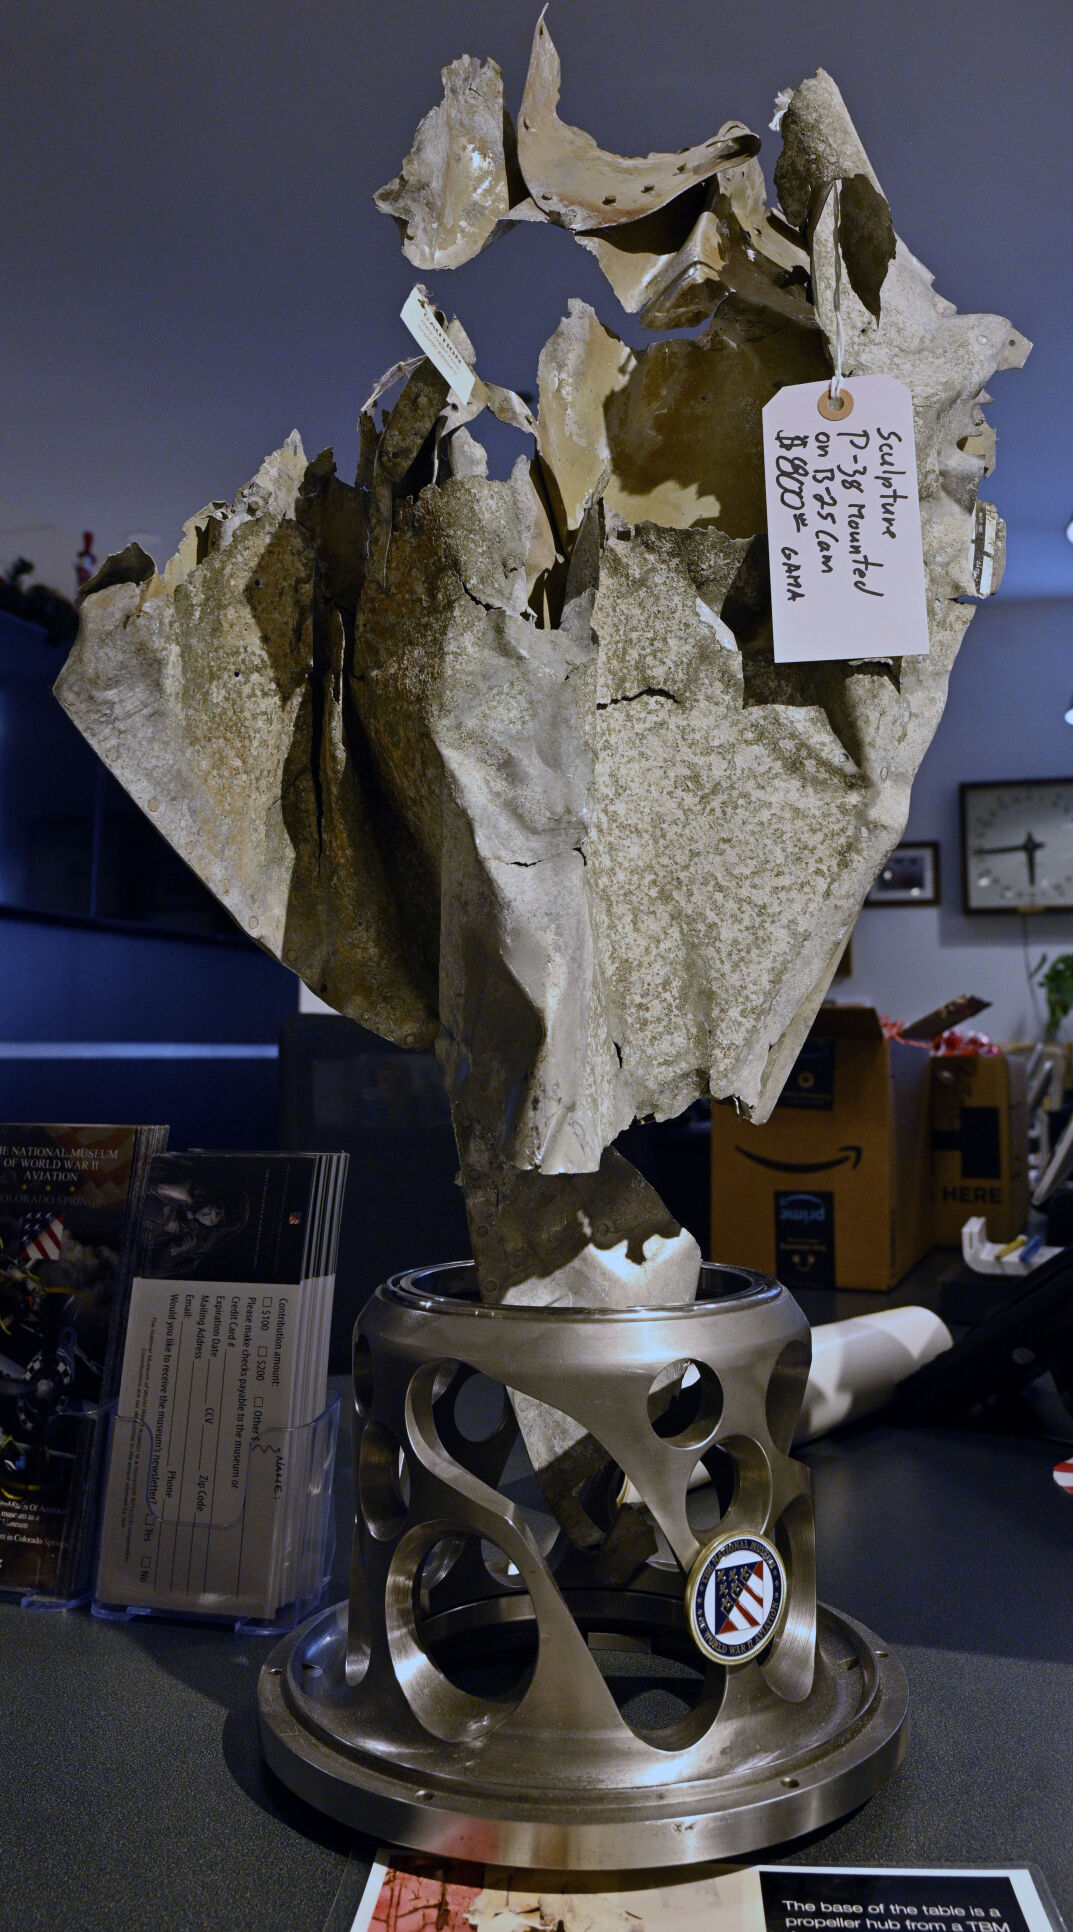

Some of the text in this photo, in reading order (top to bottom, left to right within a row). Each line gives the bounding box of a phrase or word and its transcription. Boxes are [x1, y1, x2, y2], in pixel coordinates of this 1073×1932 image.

[874, 427, 908, 539] Sculpture
[812, 431, 839, 574] on B-25 Cam
[837, 429, 885, 598] P-38 Mounted
[780, 546, 805, 602] GAMA
[3, 1158, 99, 1171] OF WORLD WAR II
[11, 1146, 67, 1158] NATIONAL
[71, 1148, 119, 1160] MUSEUM
[23, 1171, 79, 1182] AVIATION
[942, 1187, 1002, 1203] HERE
[230, 1296, 240, 1320] Credit
[261, 1310, 270, 1330] $100
[195, 1295, 209, 1359] Mailing Address
[228, 1322, 238, 1340] Card
[271, 1298, 288, 1386] Contribution amount:
[256, 1360, 266, 1381] $200
[165, 1294, 195, 1498] Email: Phone
[196, 1296, 225, 1511] Expiration Date CCV Zip Code
[231, 1297, 256, 1489] Please make checks payable to the museum or
[252, 1411, 262, 1434] Other
[140, 1294, 178, 1582] Would you like to receive the museum's newsletter? Yes No
[14, 1534, 43, 1544] Colorado
[711, 1540, 748, 1566] NATIONAL
[750, 1543, 776, 1569] MUSEUM
[704, 1631, 727, 1654] WORLD
[729, 1645, 746, 1656] WAR
[755, 1602, 779, 1643] AVIATION
[782, 1900, 1002, 1918] The base of the table is a
[785, 1917, 1011, 1932] propeller hub from a TBM
